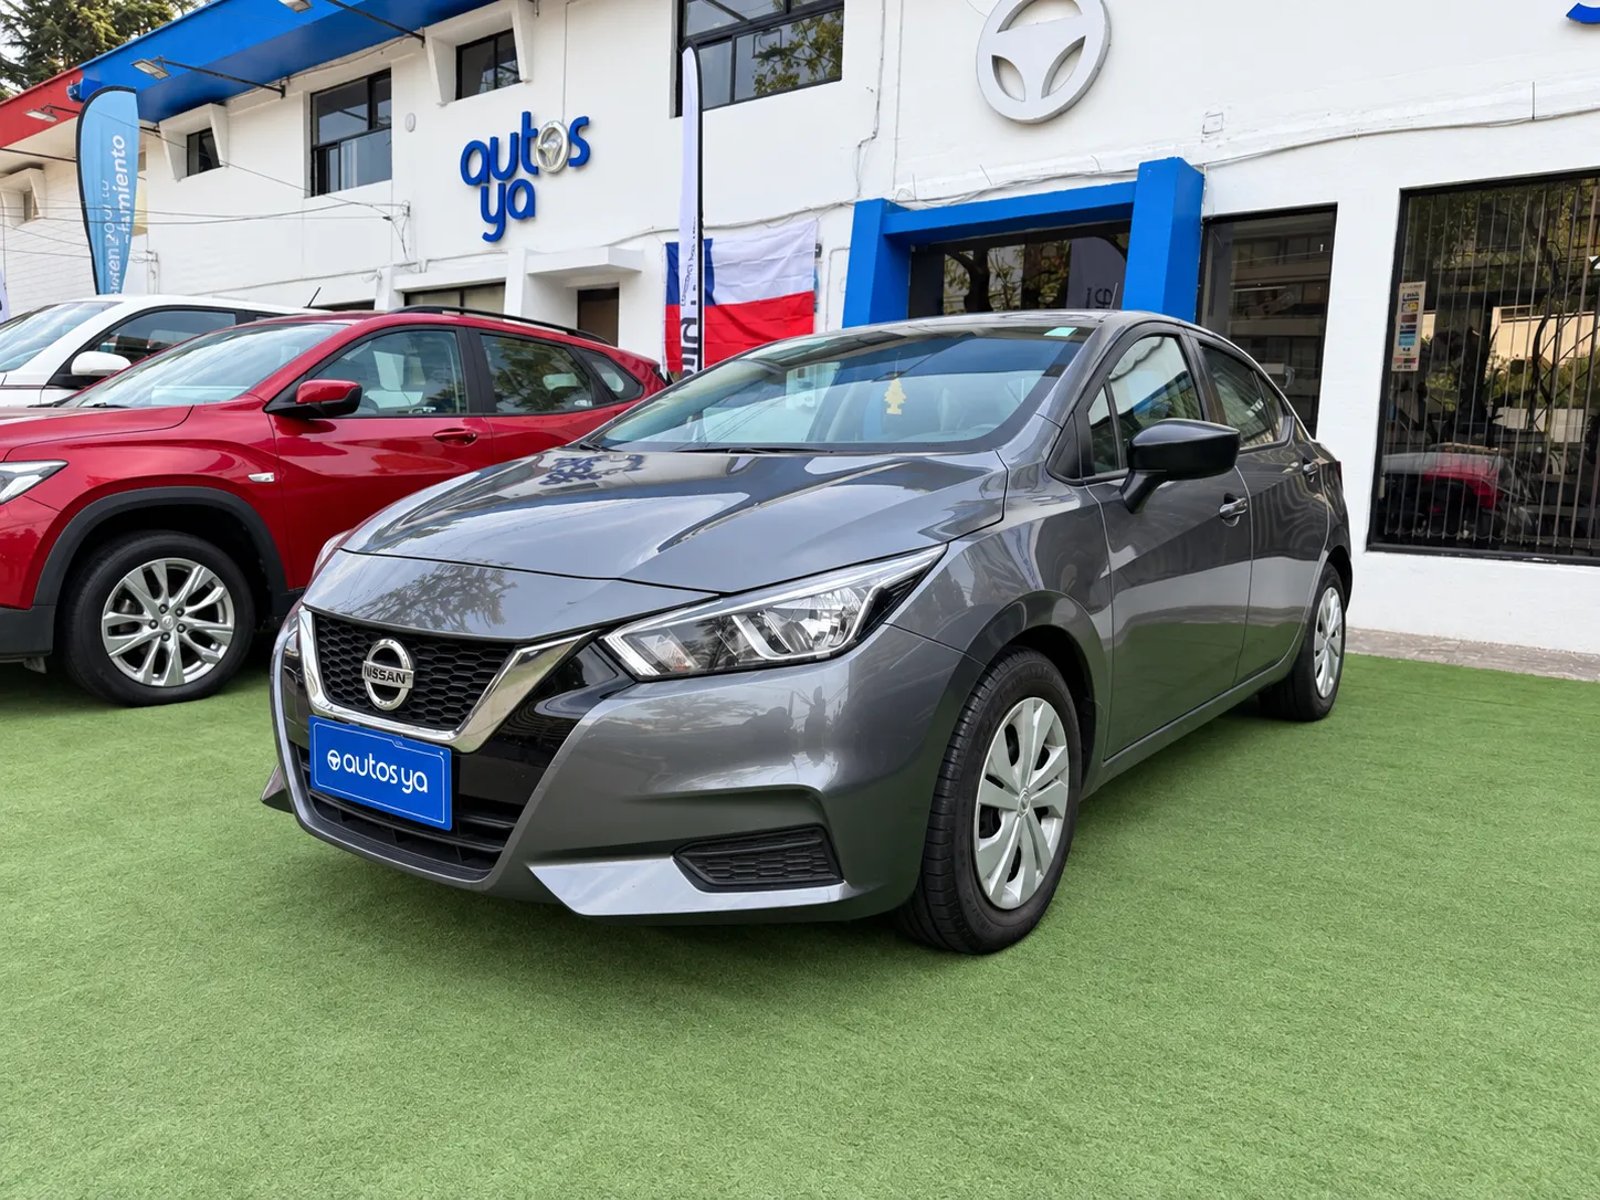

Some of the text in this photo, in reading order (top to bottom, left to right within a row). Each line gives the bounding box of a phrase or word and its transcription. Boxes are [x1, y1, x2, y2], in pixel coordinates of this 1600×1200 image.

[460, 111, 591, 186] autos
[480, 178, 536, 243] ya
[365, 664, 406, 684] NISSAN
[343, 753, 428, 793] autos ya
